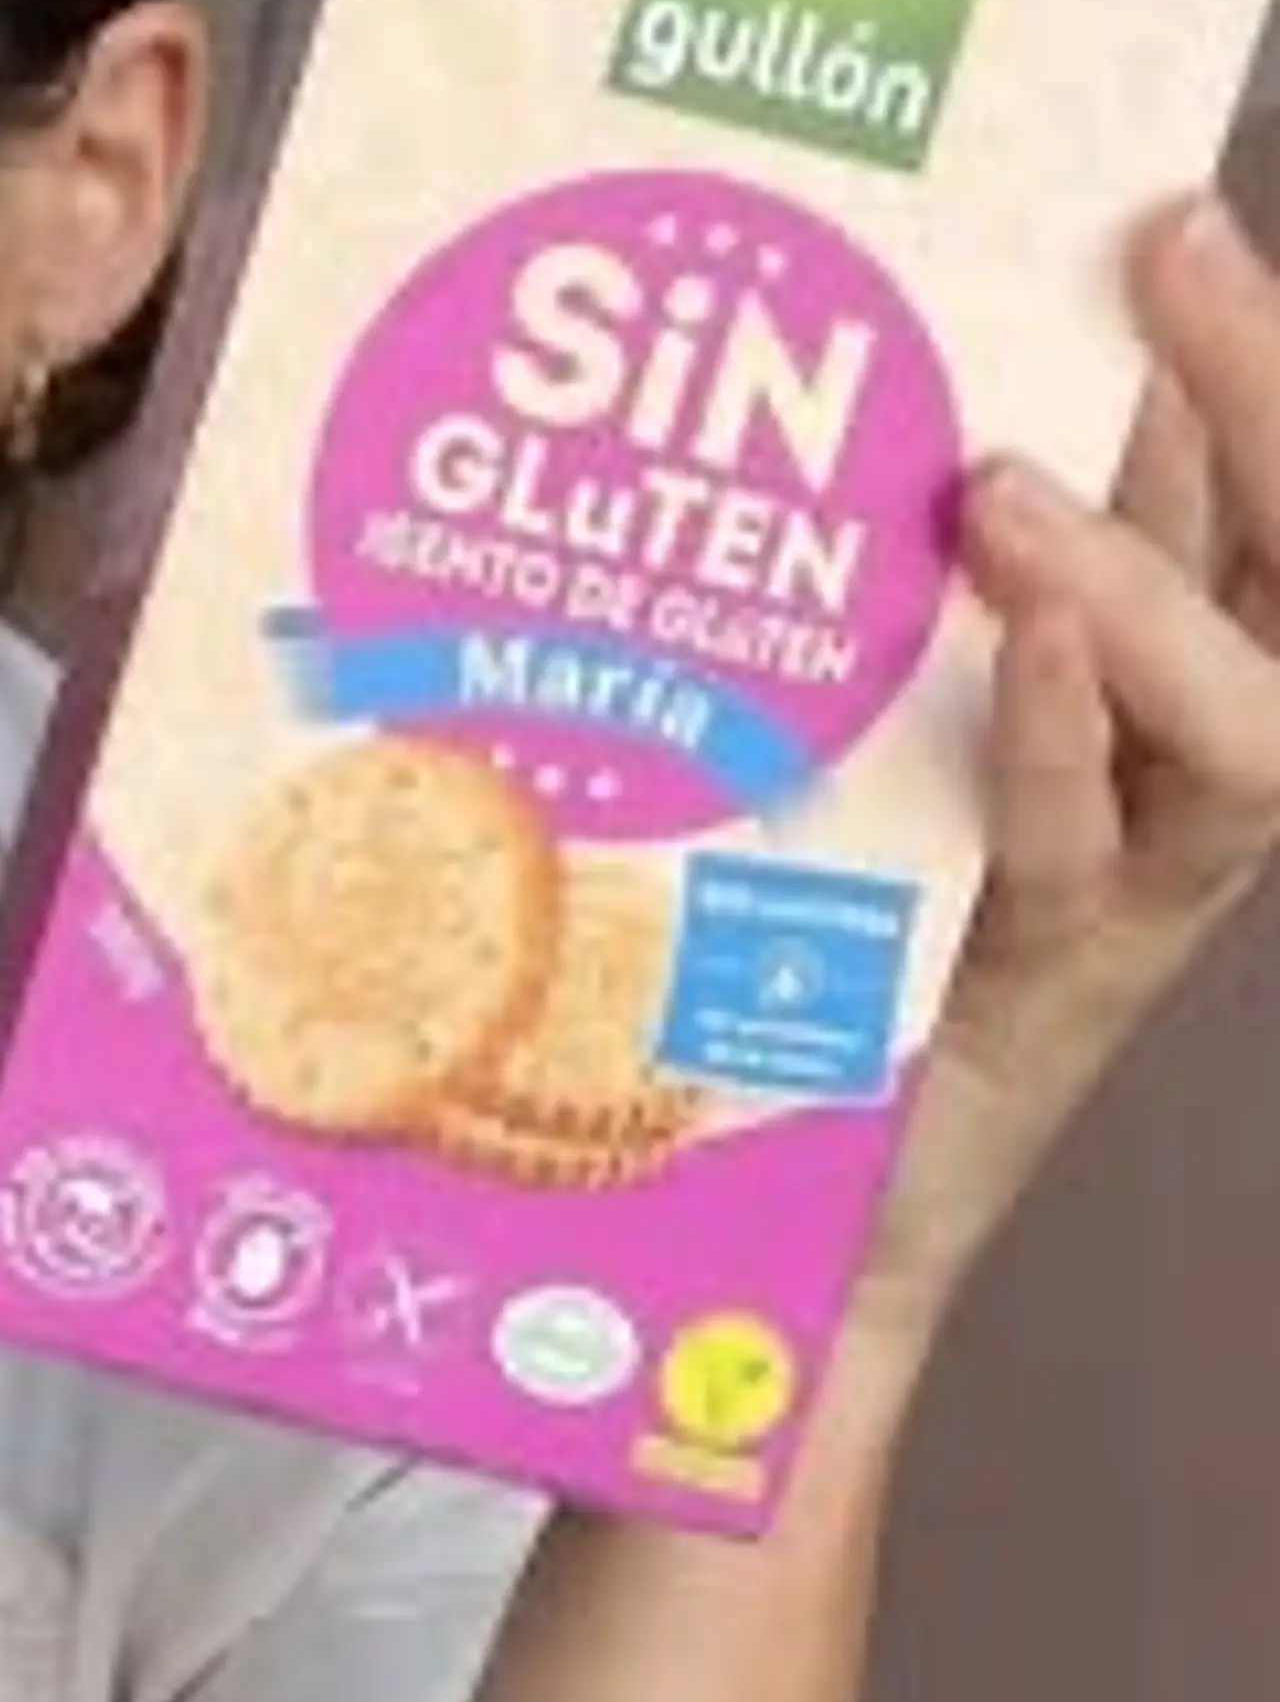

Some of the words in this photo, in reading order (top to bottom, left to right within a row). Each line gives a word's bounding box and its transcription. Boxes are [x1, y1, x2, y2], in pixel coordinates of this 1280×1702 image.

[626, 0, 932, 136] gullón
[491, 242, 878, 493] SiN
[408, 412, 868, 613] GLuTEN
